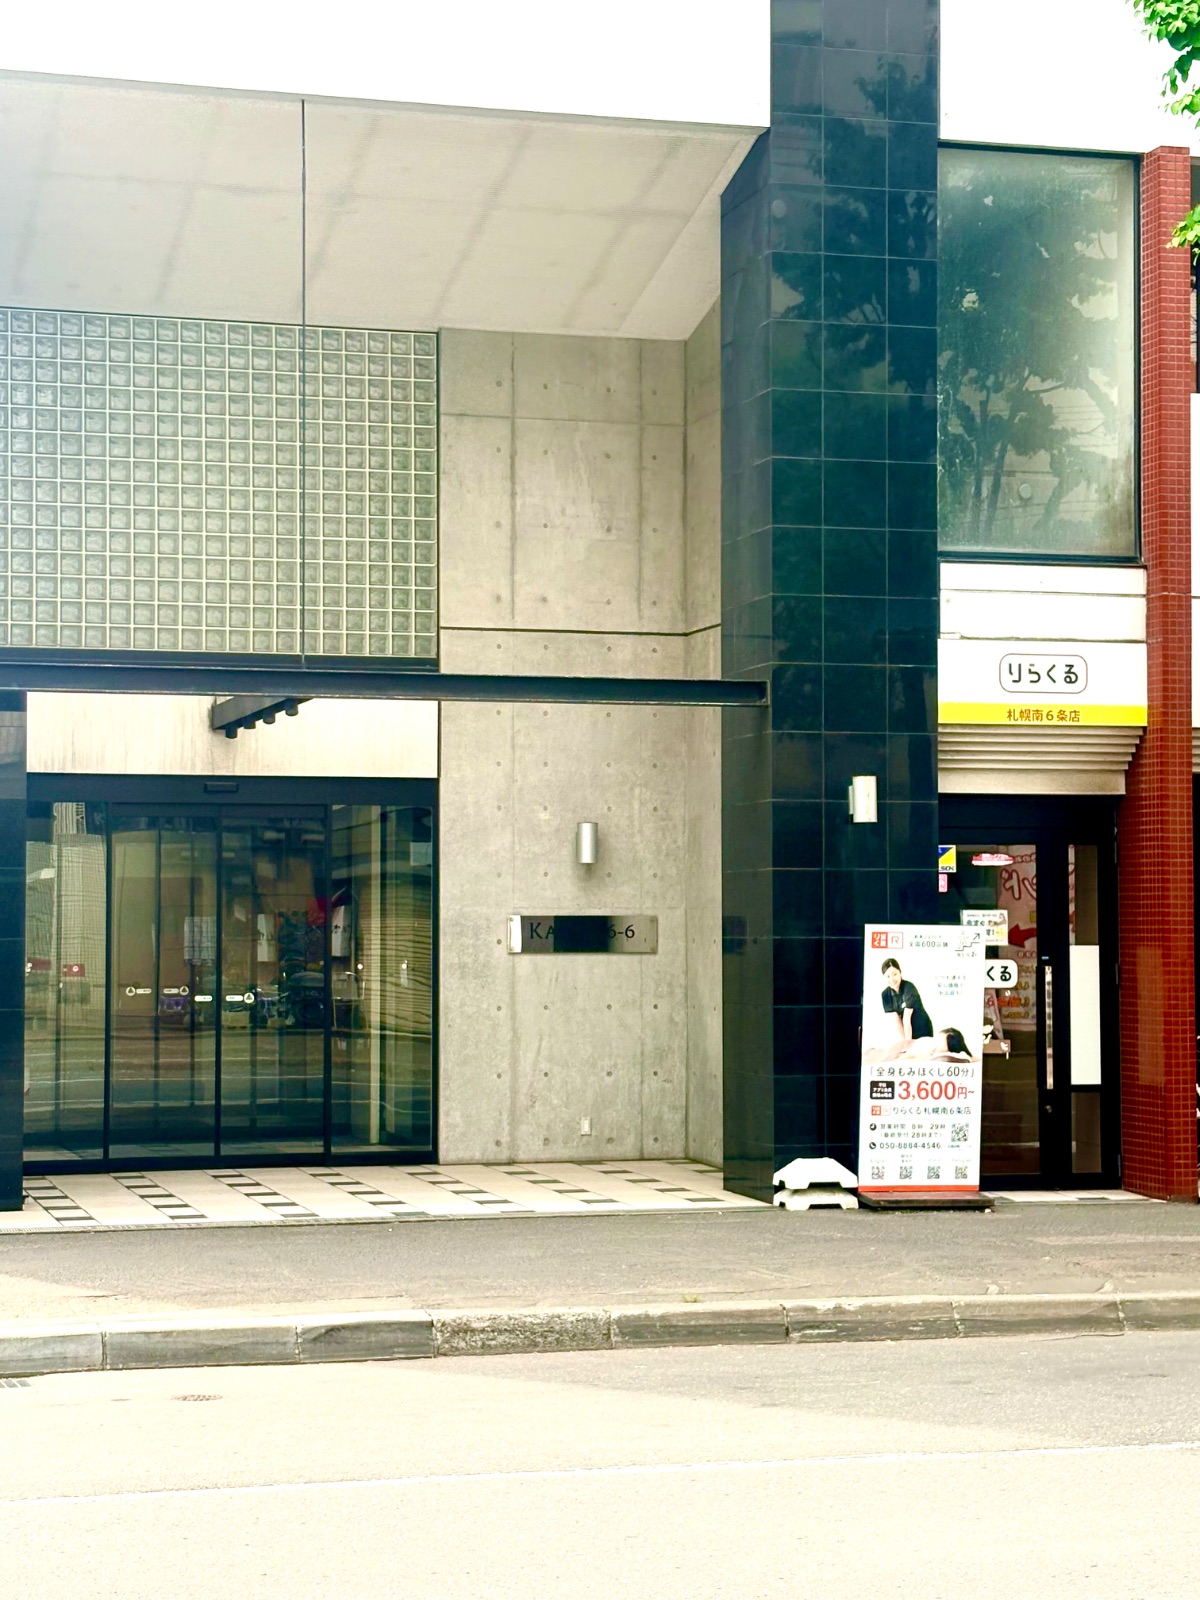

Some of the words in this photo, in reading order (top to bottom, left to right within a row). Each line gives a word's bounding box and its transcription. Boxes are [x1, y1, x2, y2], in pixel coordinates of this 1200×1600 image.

[1008, 662, 1079, 684] りらくる
[1007, 708, 1080, 722] 札幌南6条店
